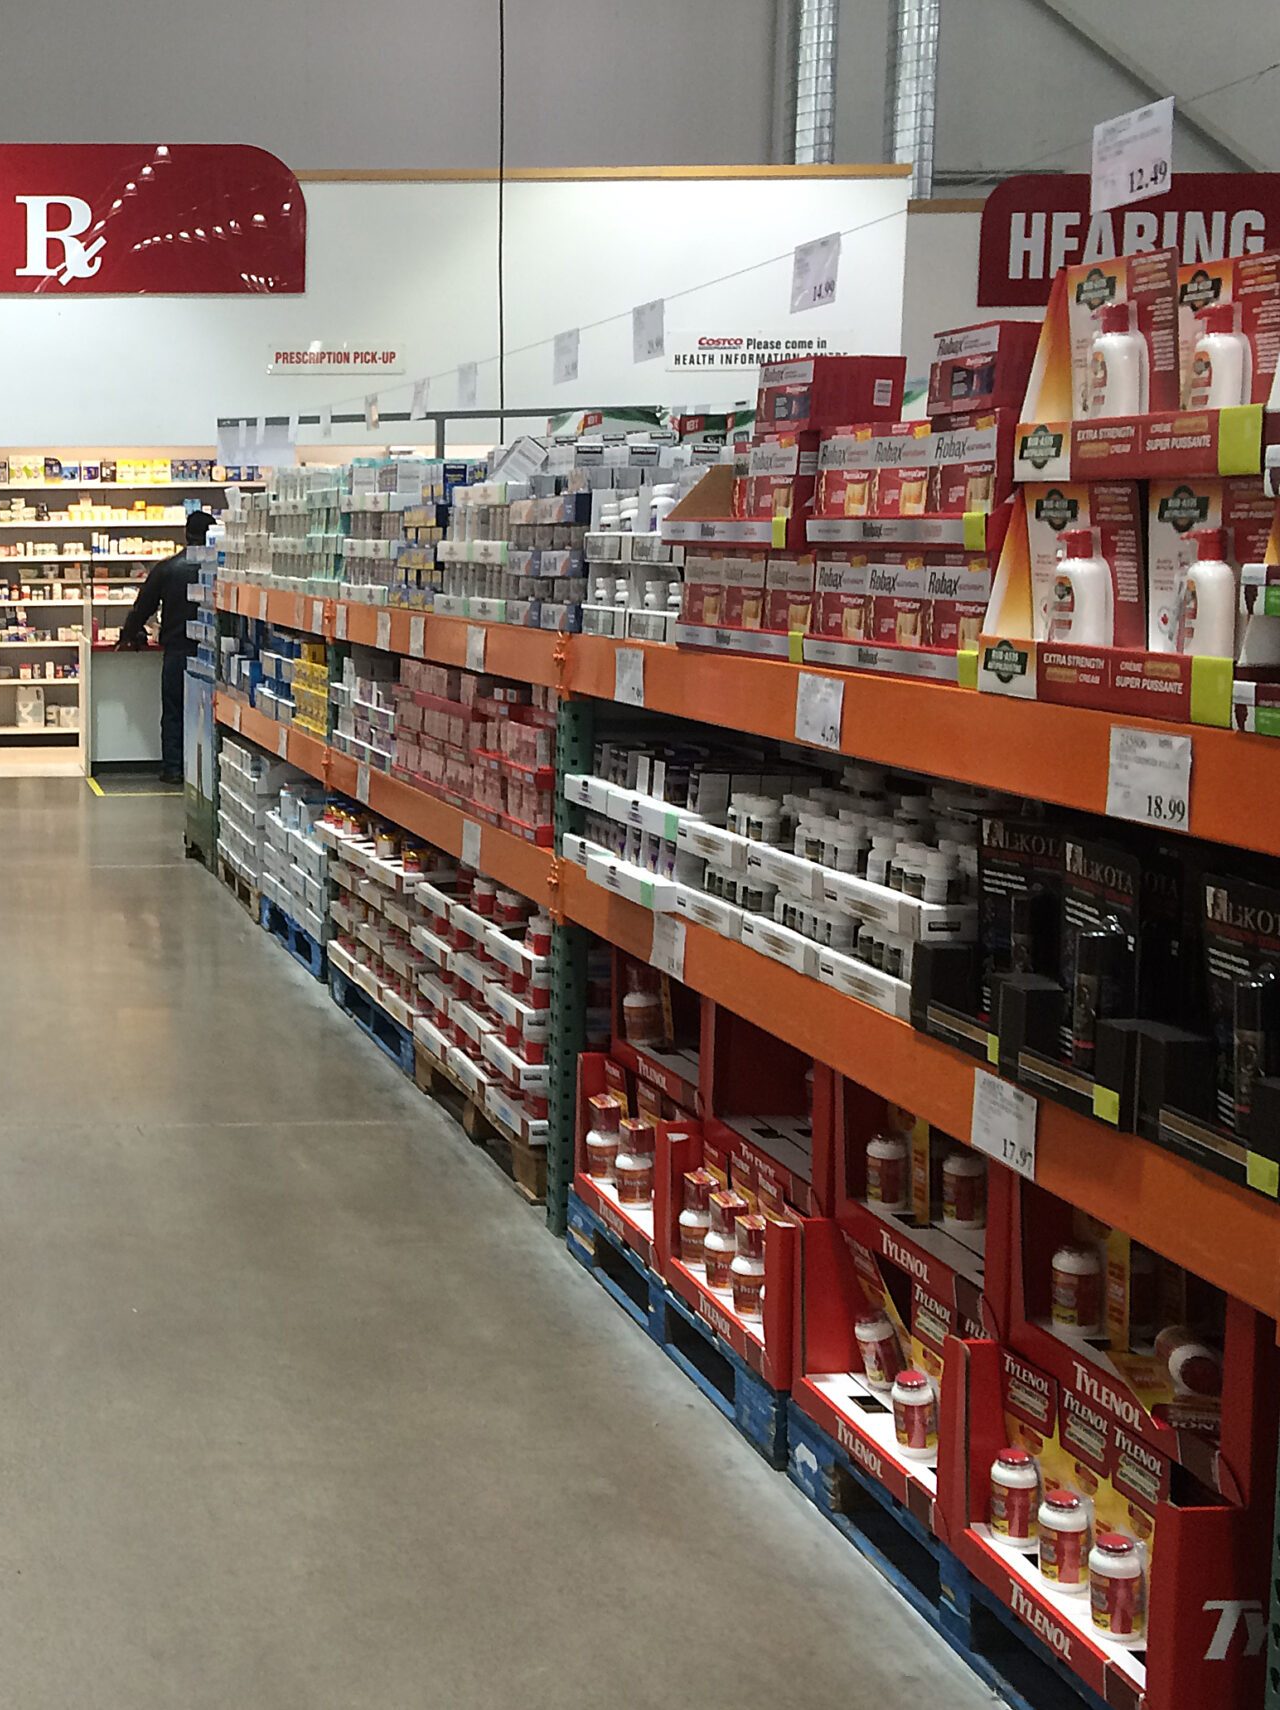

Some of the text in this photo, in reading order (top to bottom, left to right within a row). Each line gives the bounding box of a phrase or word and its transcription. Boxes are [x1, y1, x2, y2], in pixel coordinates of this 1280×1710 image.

[1128, 159, 1168, 193] 12.49
[1008, 209, 1266, 280] HEARING
[275, 352, 396, 364] PRESCRIPTION PICK-UP
[674, 354, 715, 365] HEALTH
[720, 352, 799, 365] INFORMATION
[746, 337, 827, 350] Please come in
[935, 436, 969, 460] Robax
[1146, 439, 1170, 451] SUPER
[870, 569, 899, 595] Robax
[928, 572, 960, 598] Robax
[1043, 653, 1105, 668] EXTRA STRENGTH
[1115, 676, 1184, 695] SUPER PUISSANTE
[1146, 795, 1186, 823] 18.99
[1002, 1137, 1033, 1172] 17.97
[880, 1229, 930, 1284] TYLENOL
[697, 1290, 732, 1340] TYLENOL
[914, 1282, 952, 1325] TYLENOL
[1003, 1353, 1050, 1396] TYLENOL
[1062, 1387, 1109, 1436] TYLENOL
[1072, 1360, 1143, 1432] TYLENOL
[835, 1415, 884, 1480] TYLENOL
[1114, 1425, 1163, 1477] TYLENOL
[1009, 1577, 1072, 1661] TYLENOL
